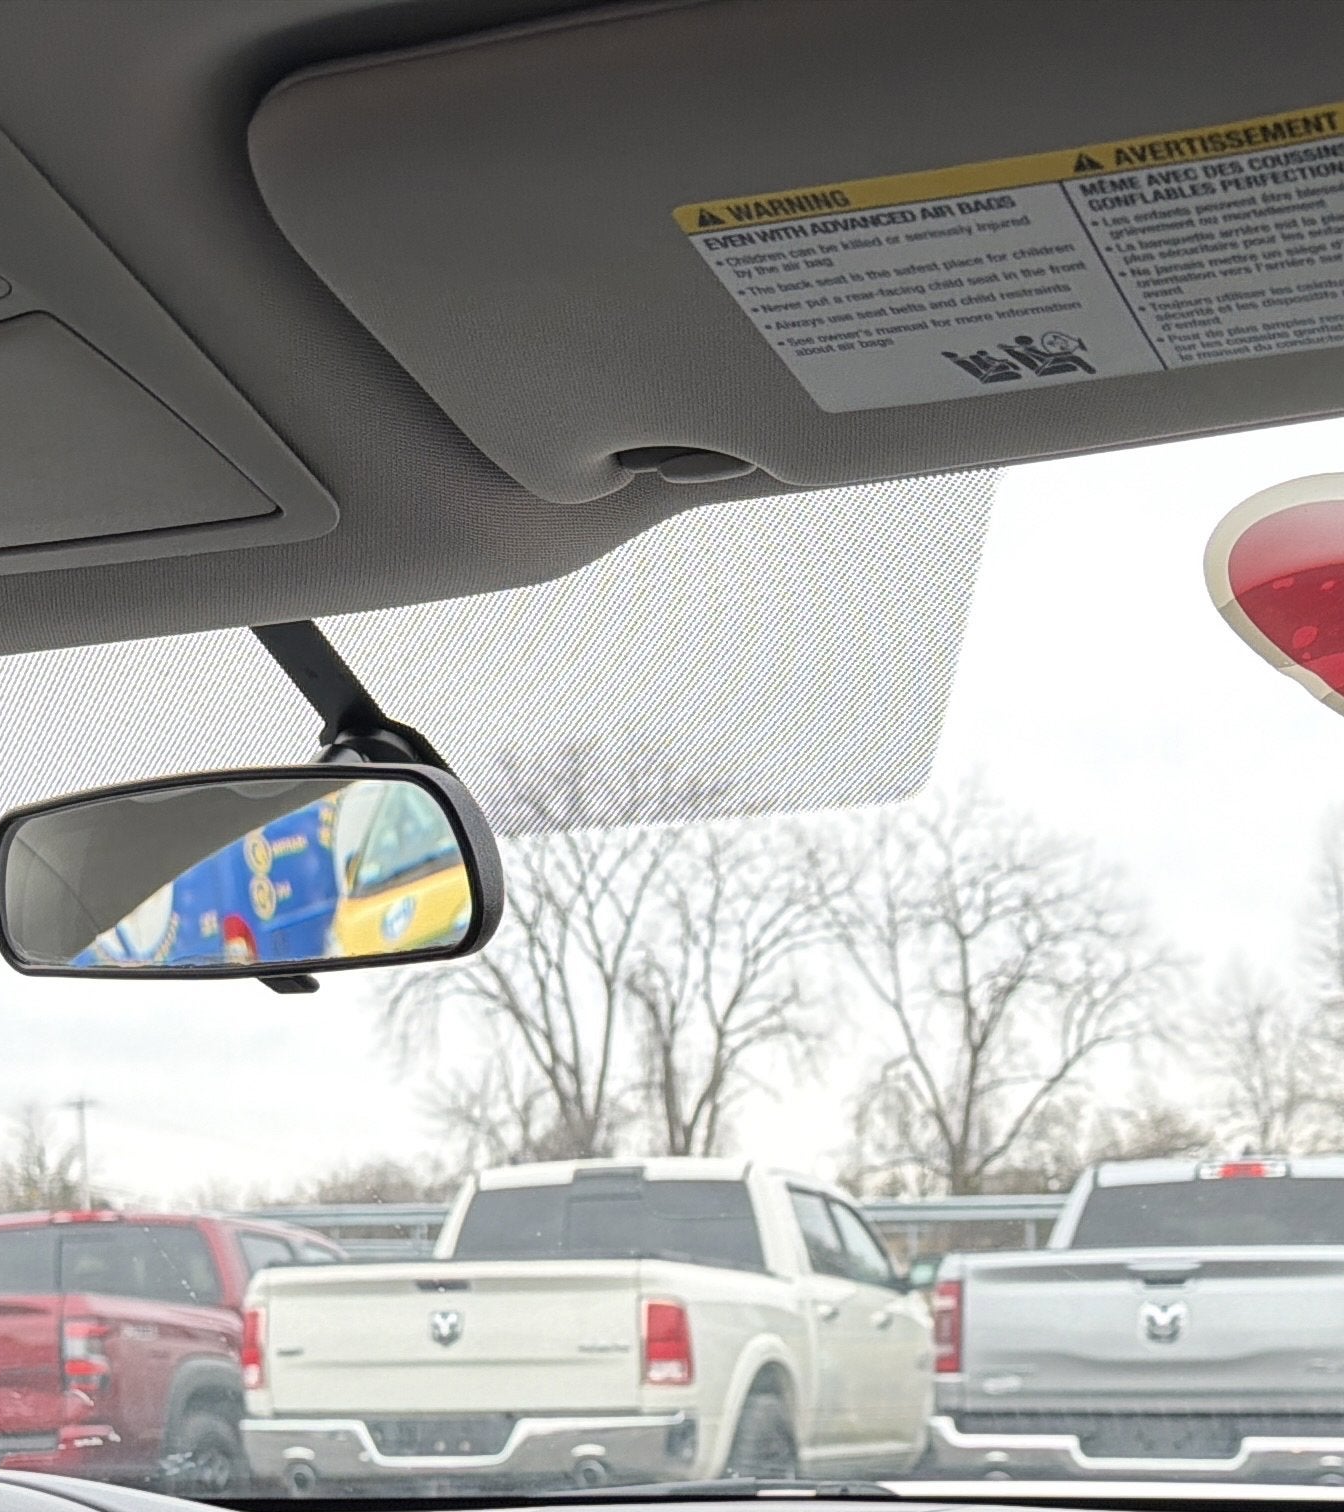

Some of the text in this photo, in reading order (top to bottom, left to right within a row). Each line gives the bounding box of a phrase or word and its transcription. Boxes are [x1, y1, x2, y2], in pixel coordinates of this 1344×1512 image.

[1115, 111, 1338, 166] AVERTISSEMENT
[1080, 177, 1137, 197] MÊME
[1147, 169, 1198, 186] AVEC
[1203, 162, 1244, 179] DES
[1088, 183, 1216, 212] GONFLABLES
[703, 196, 1017, 252] EVEN WITH ADVANCED AIR BAGS
[726, 190, 851, 223] WARNING
[725, 252, 787, 268] Children
[788, 247, 817, 259] can
[818, 244, 839, 254] be
[840, 236, 883, 251] killed
[885, 235, 900, 245] or
[905, 225, 973, 242] seriously
[754, 266, 780, 276] the
[782, 261, 801, 272] air
[803, 257, 834, 269] bag
[746, 286, 776, 296] The
[776, 279, 814, 293] back
[815, 274, 849, 287] seat
[864, 269, 892, 280] the
[893, 262, 941, 276] safest
[942, 257, 984, 271] place
[985, 253, 1007, 263] for
[1012, 243, 1075, 260] children
[759, 301, 802, 314] Never
[804, 296, 831, 309] put
[928, 277, 964, 291] child
[966, 273, 1001, 286] seat
[1001, 271, 1019, 281] in
[1019, 267, 1046, 278] the
[1048, 260, 1087, 274] front
[775, 317, 825, 331] Always
[827, 313, 854, 324] use
[856, 307, 888, 320] seat
[888, 303, 927, 315] belts
[929, 298, 958, 310] and
[960, 292, 997, 306] child
[786, 336, 815, 347] See
[875, 321, 929, 335] manual
[930, 318, 952, 328] for
[954, 313, 994, 325] more
[995, 302, 1082, 319] information
[795, 338, 894, 357] about air bags
